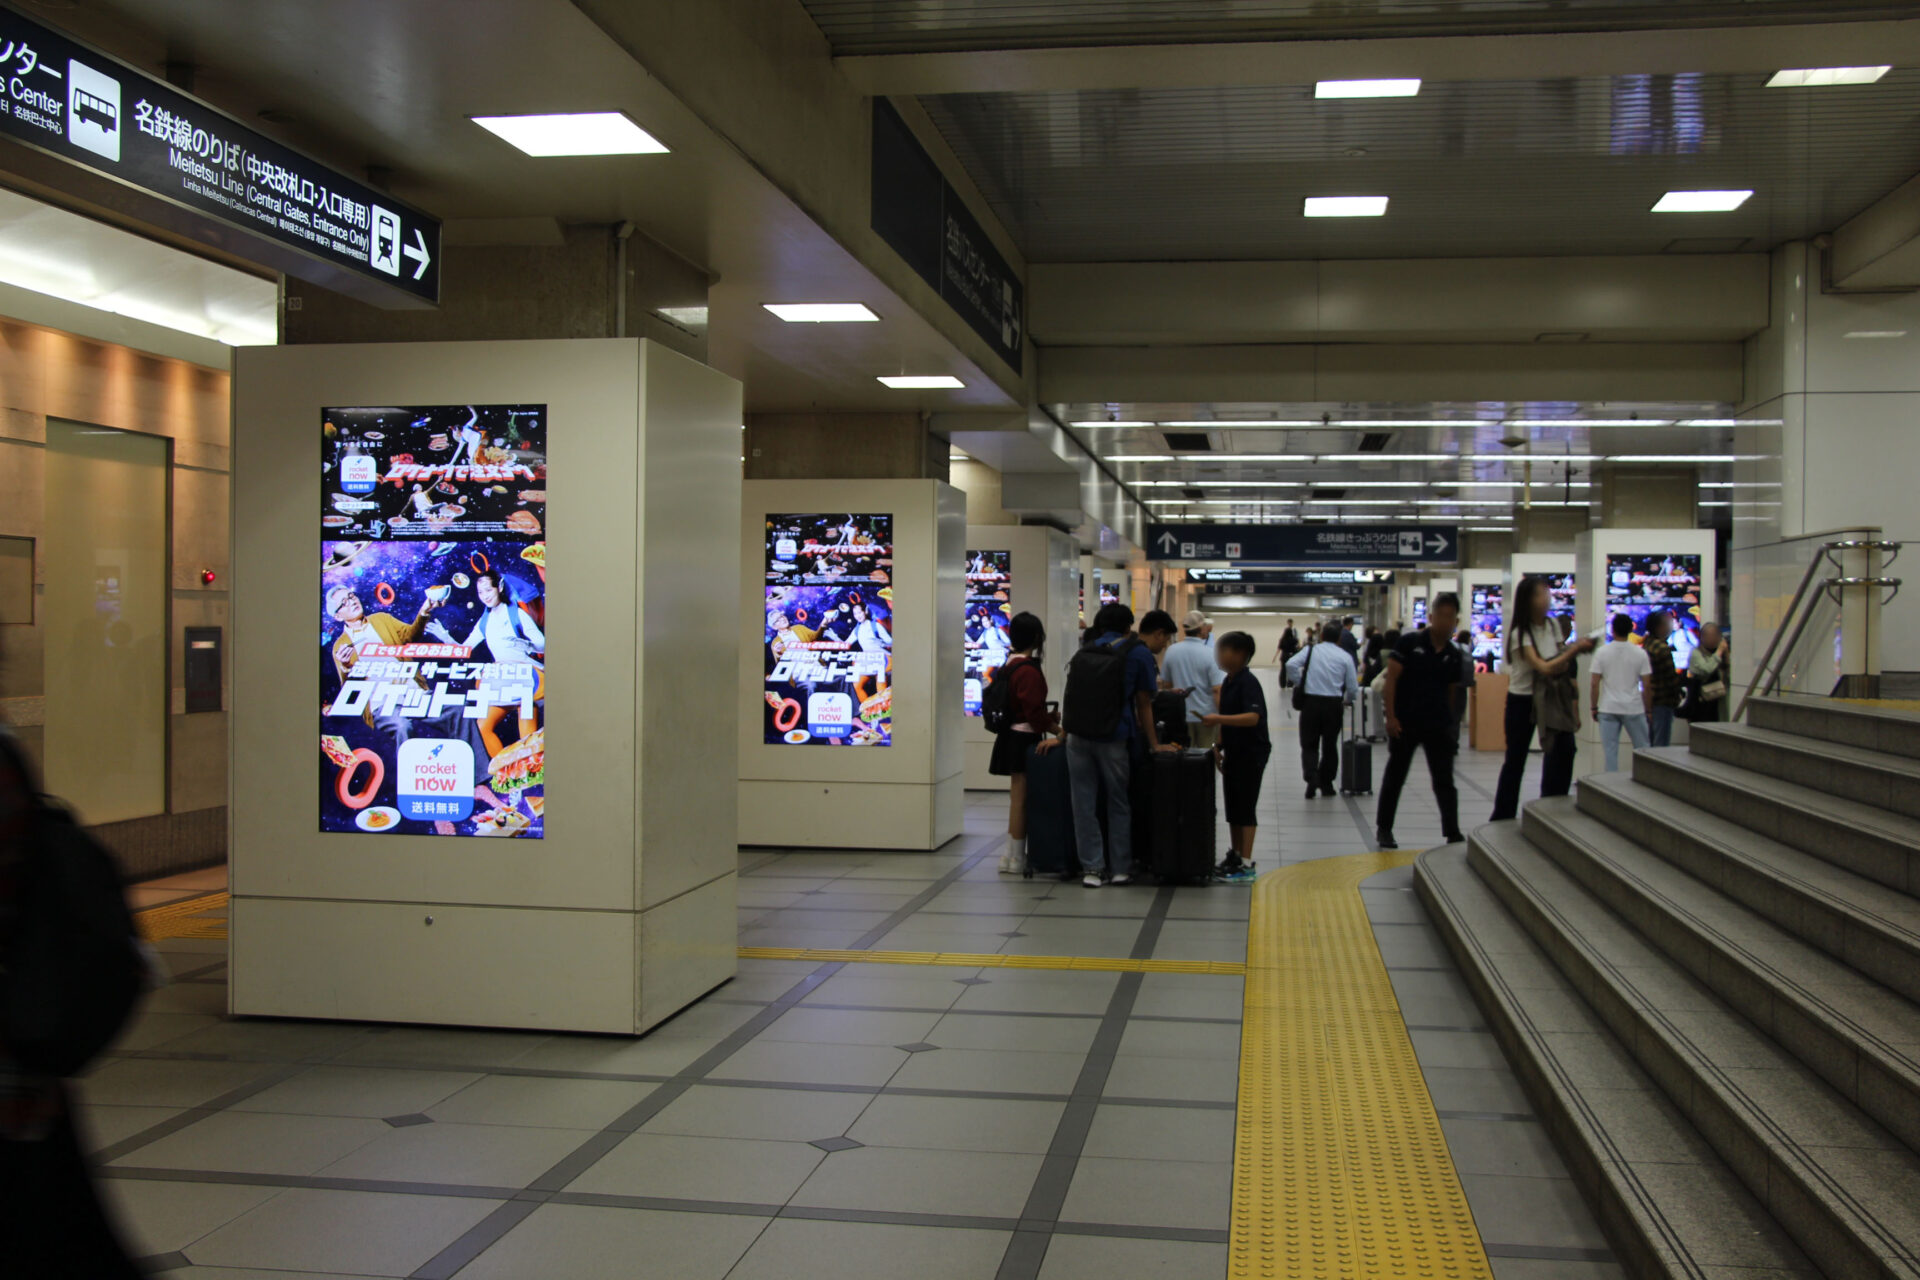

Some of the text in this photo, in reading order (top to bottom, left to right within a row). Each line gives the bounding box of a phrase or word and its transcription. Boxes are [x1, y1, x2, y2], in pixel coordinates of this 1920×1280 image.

[10, 77, 63, 117] Center
[169, 147, 370, 253] Meitetsu Line (Central Gates, Entrance Only)
[183, 177, 202, 195] Linha
[202, 185, 230, 207] Meitetsu
[256, 209, 278, 229] Central)
[329, 680, 534, 720] ロケットナウ
[818, 713, 842, 721] now
[415, 762, 457, 775] rocket
[415, 777, 457, 792] now
[411, 801, 460, 815] 送料無料
